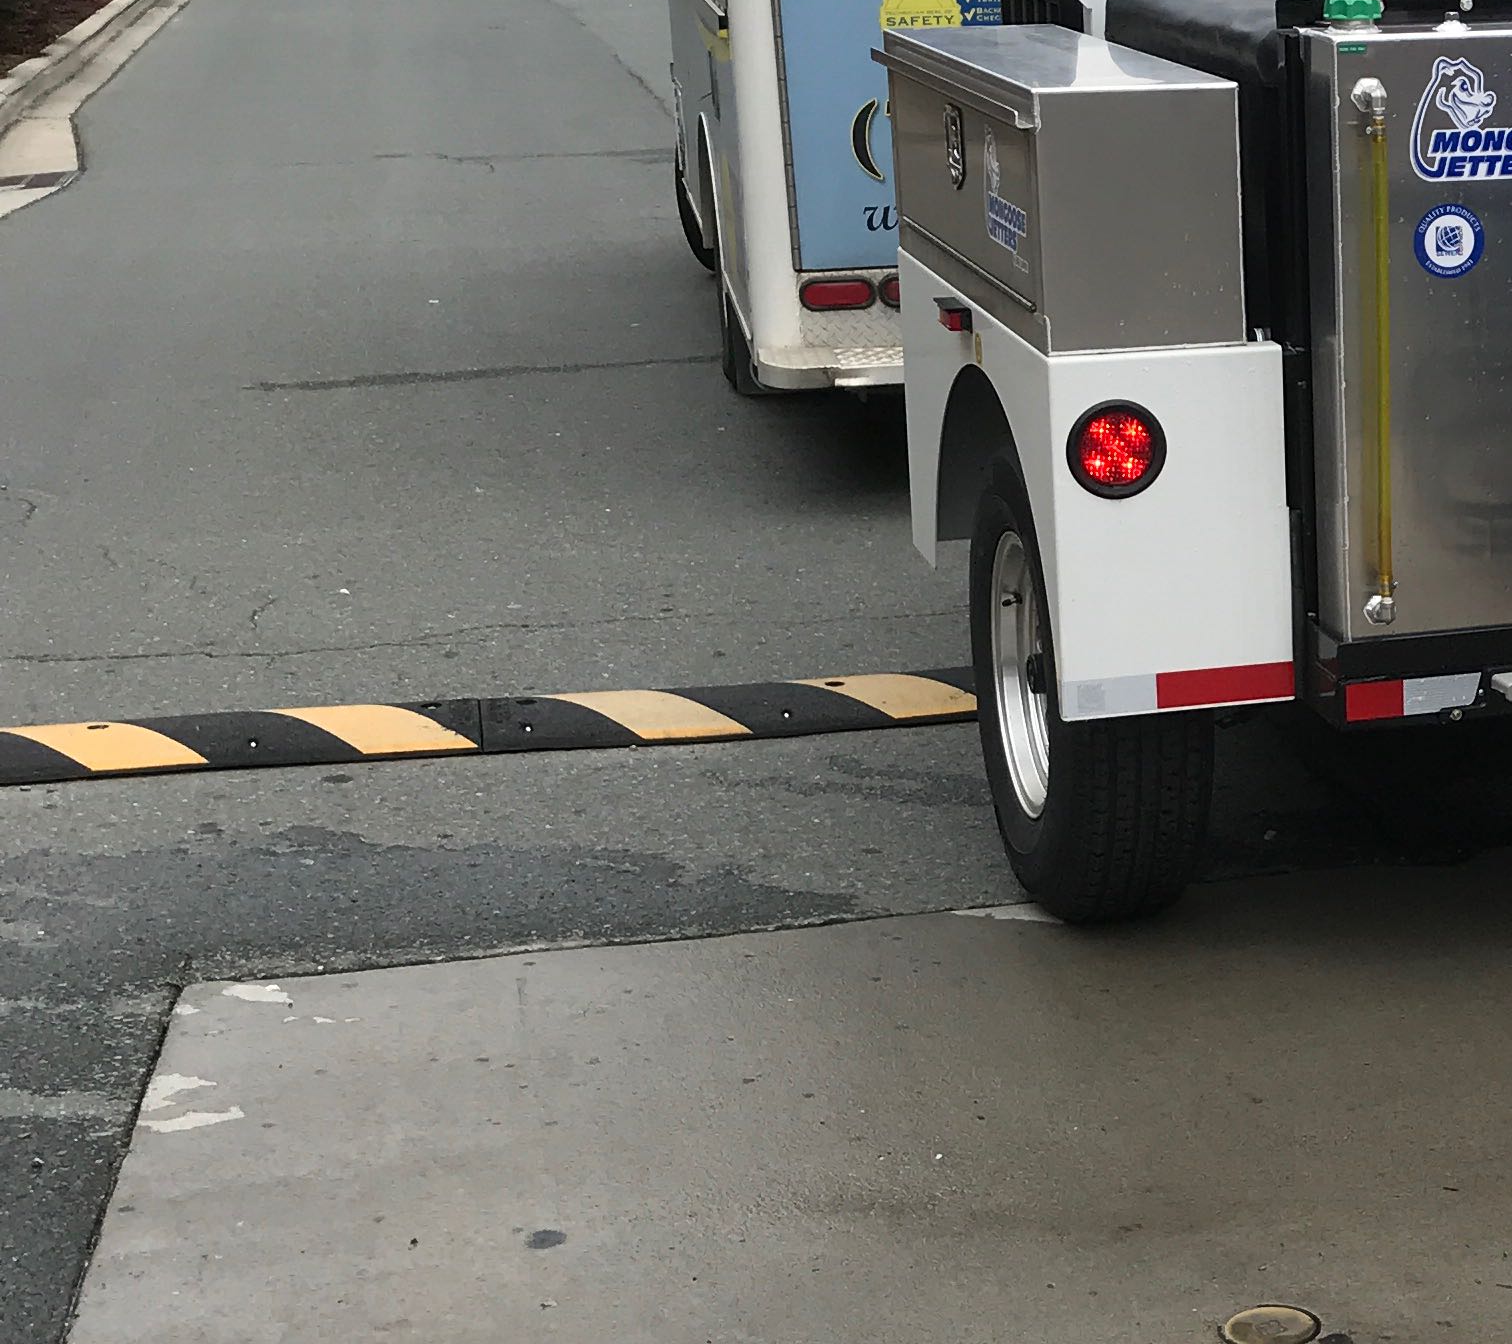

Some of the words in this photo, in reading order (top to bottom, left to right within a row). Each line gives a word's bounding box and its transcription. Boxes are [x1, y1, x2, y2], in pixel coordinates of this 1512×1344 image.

[887, 15, 954, 26] SAFETY
[1418, 207, 1445, 234] QUALITY
[1446, 205, 1481, 232] PRODUCTS
